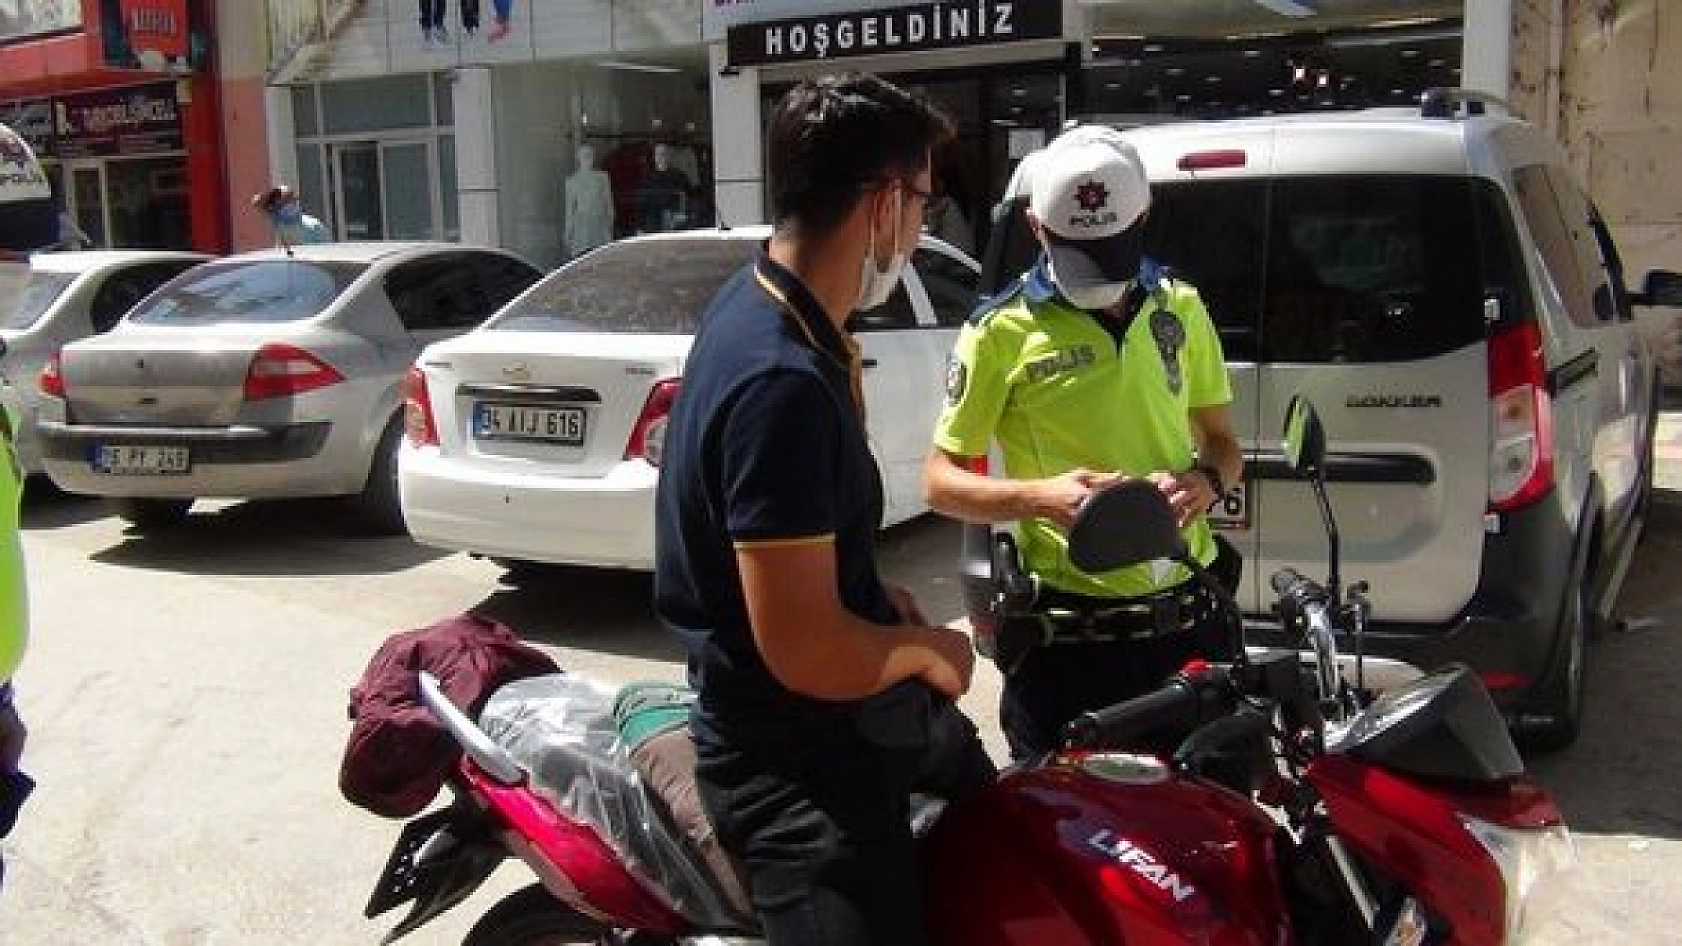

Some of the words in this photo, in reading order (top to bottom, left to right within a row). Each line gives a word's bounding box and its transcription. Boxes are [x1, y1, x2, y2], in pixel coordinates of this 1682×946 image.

[765, 0, 1013, 57] HOŞGELDİNİZ
[546, 411, 580, 436] 616
[1087, 828, 1195, 902] LIFAN
